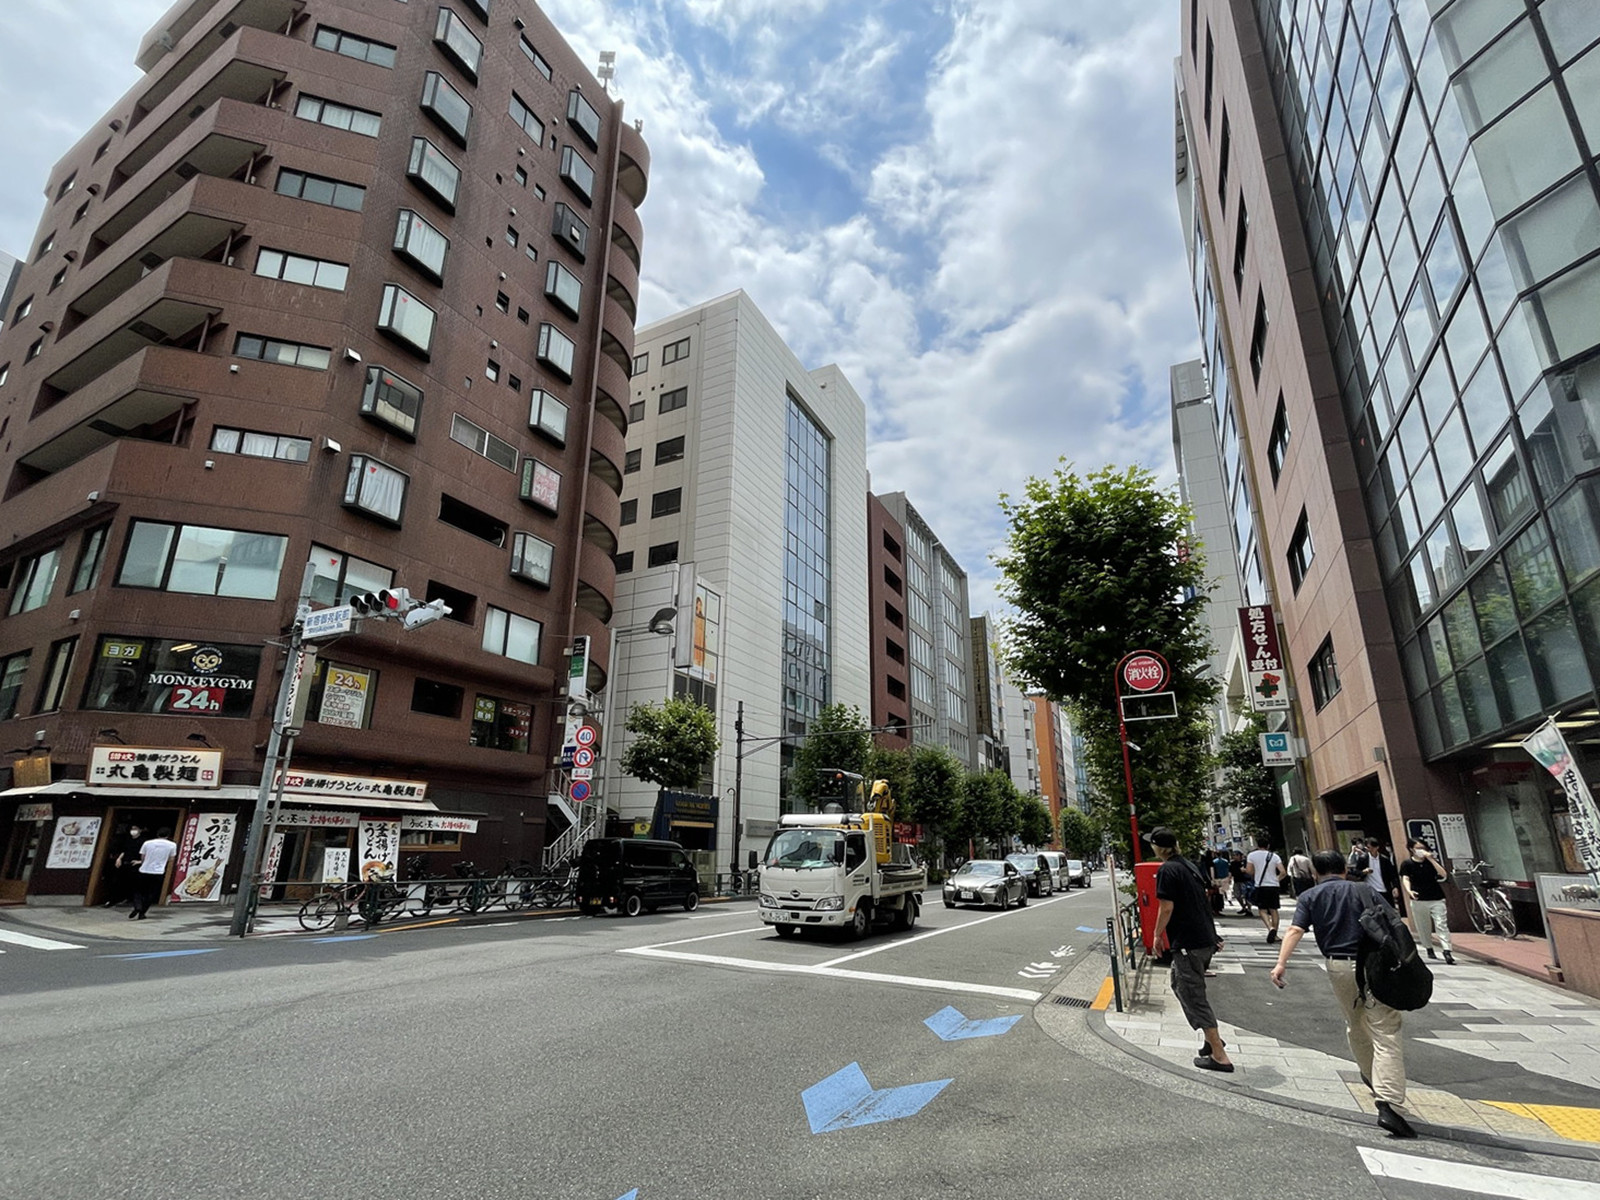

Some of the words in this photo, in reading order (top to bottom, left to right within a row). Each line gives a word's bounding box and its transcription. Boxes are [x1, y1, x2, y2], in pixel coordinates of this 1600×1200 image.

[1248, 607, 1271, 659] 処方せん
[108, 645, 137, 656] ヨガ
[1128, 665, 1160, 681] 消火栓
[1251, 659, 1278, 671] 受付
[148, 673, 254, 690] MONKEYGYM
[335, 672, 361, 689] 24h
[173, 688, 220, 711] 24h
[580, 731, 591, 741] 40
[106, 763, 200, 782] 丸亀製麺
[370, 784, 417, 797] 丸亀製麺
[203, 818, 221, 860] うどん
[364, 822, 377, 859] うどん
[375, 822, 390, 862] 釜揚げ
